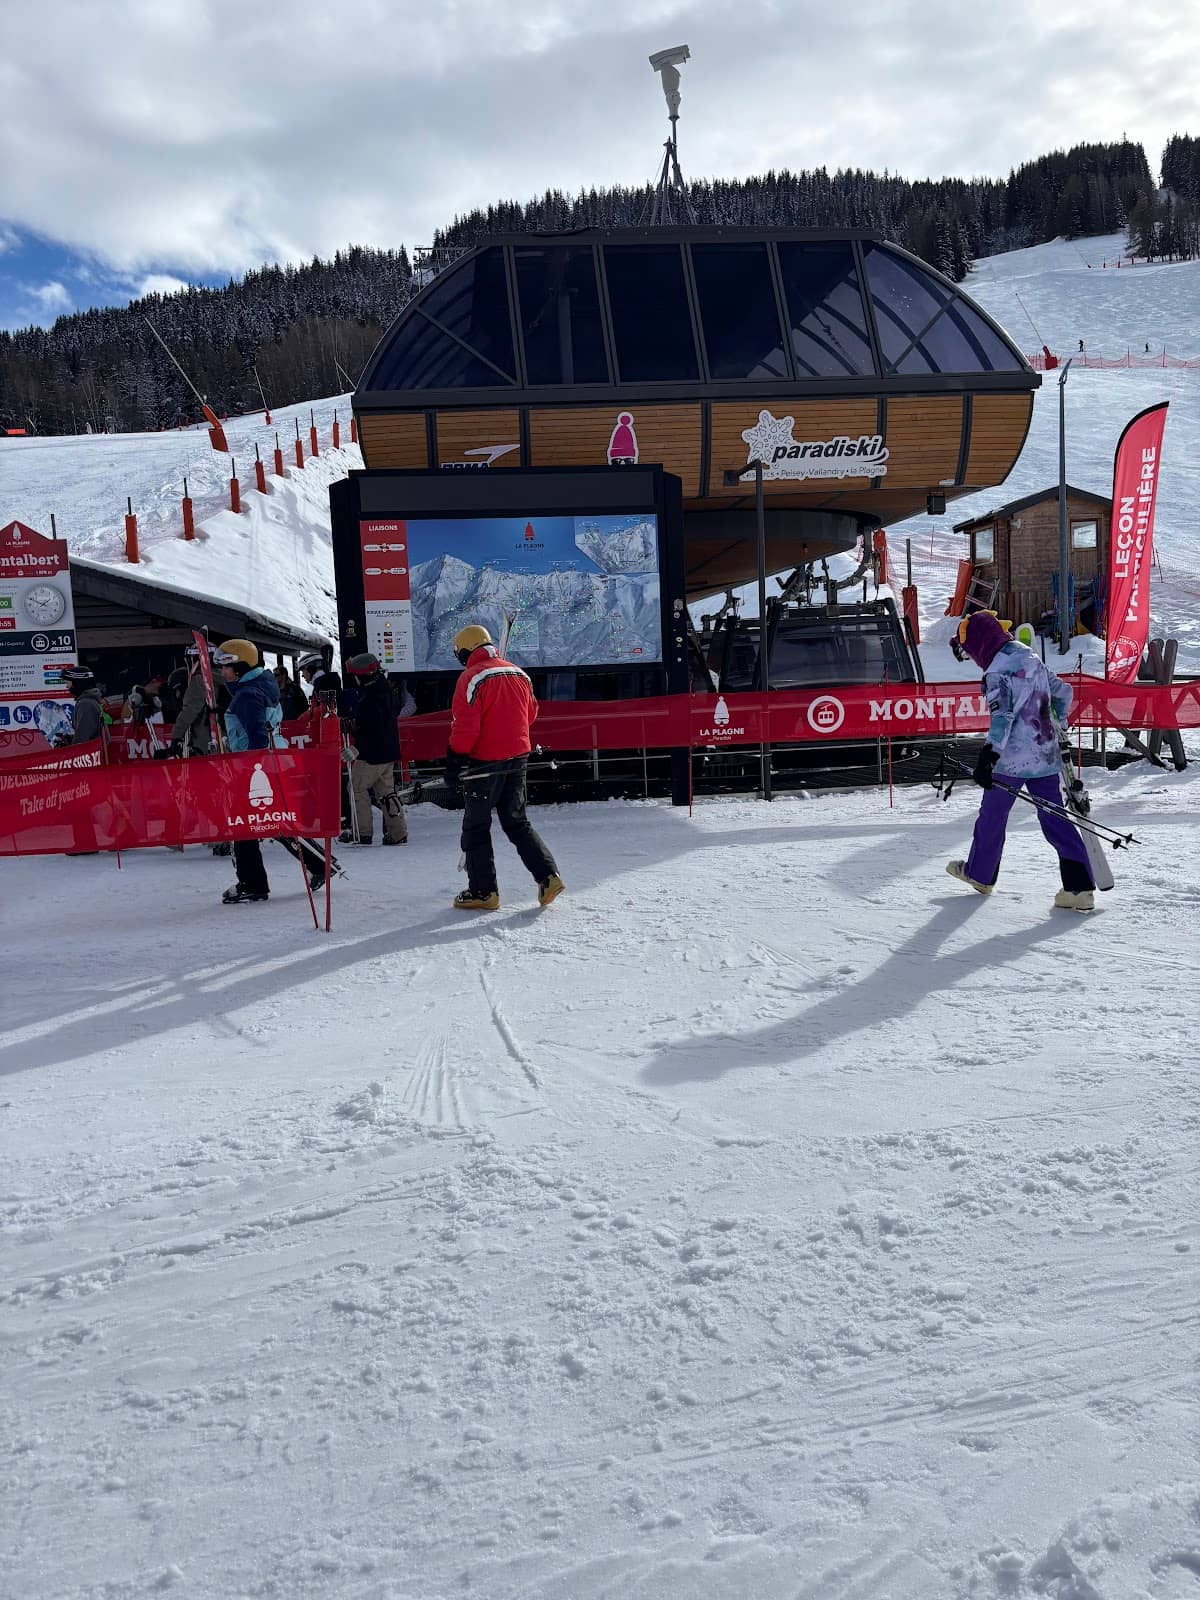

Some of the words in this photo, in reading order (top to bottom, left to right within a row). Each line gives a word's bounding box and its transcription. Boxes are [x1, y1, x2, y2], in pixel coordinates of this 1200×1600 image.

[771, 437, 881, 463] paradiski
[860, 463, 885, 476] Plagne
[1114, 496, 1135, 579] LEÇON
[0, 554, 60, 567] ntalbert
[57, 635, 71, 646] 10
[869, 696, 991, 722] MONTAL
[712, 727, 745, 736] PLAGNE
[20, 795, 44, 816] Take
[46, 790, 58, 808] off
[58, 787, 76, 810] your
[76, 781, 91, 798] skis
[227, 816, 244, 826] LA
[248, 811, 297, 825] PLAGNE
